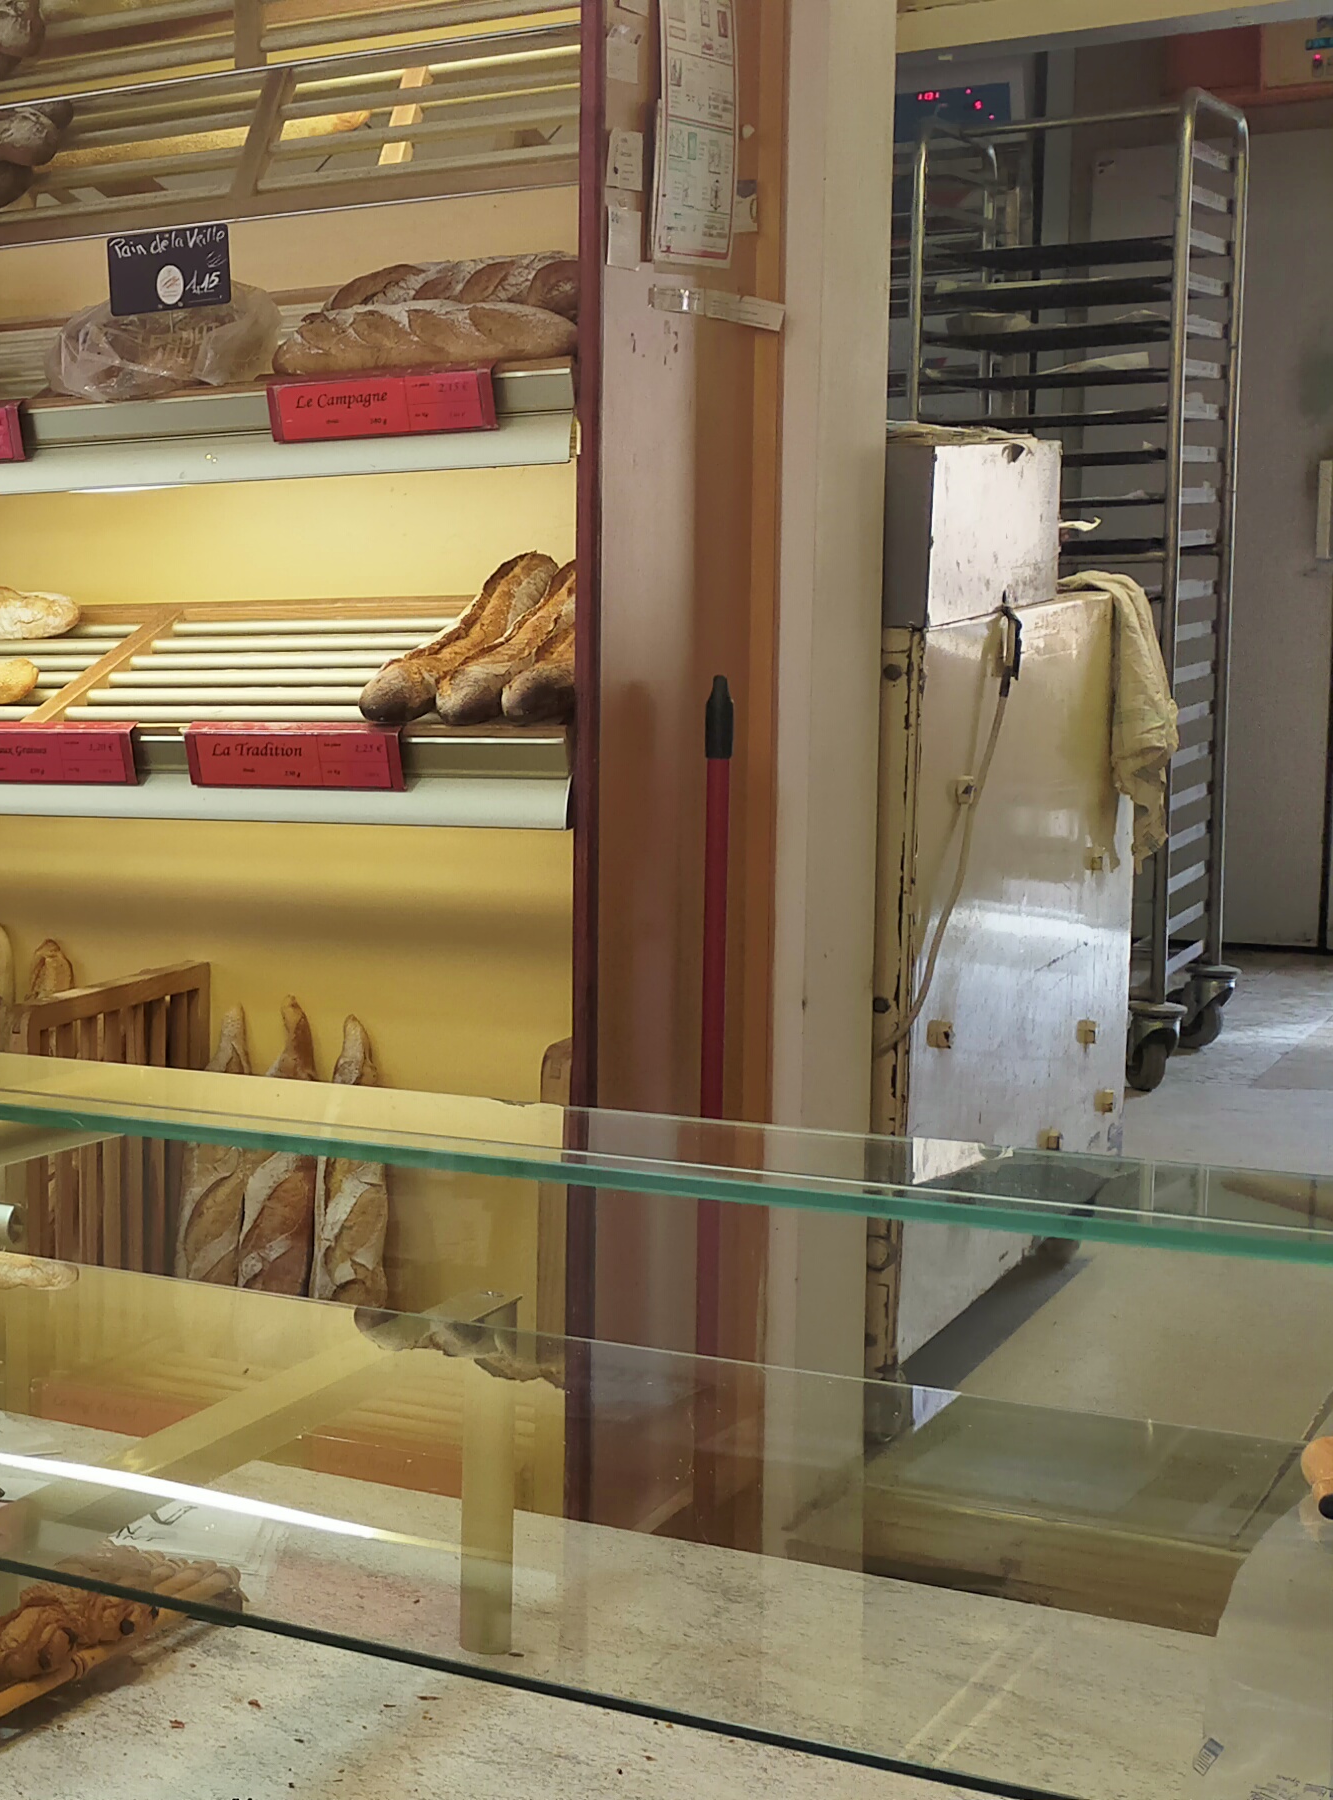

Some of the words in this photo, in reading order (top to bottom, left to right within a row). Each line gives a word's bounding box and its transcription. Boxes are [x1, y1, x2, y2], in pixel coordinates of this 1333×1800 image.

[109, 237, 147, 259] Pain
[171, 231, 184, 249] la
[296, 394, 313, 409] Le
[317, 391, 388, 409] Campagne
[212, 743, 231, 757] La
[234, 742, 303, 757] Tradition
